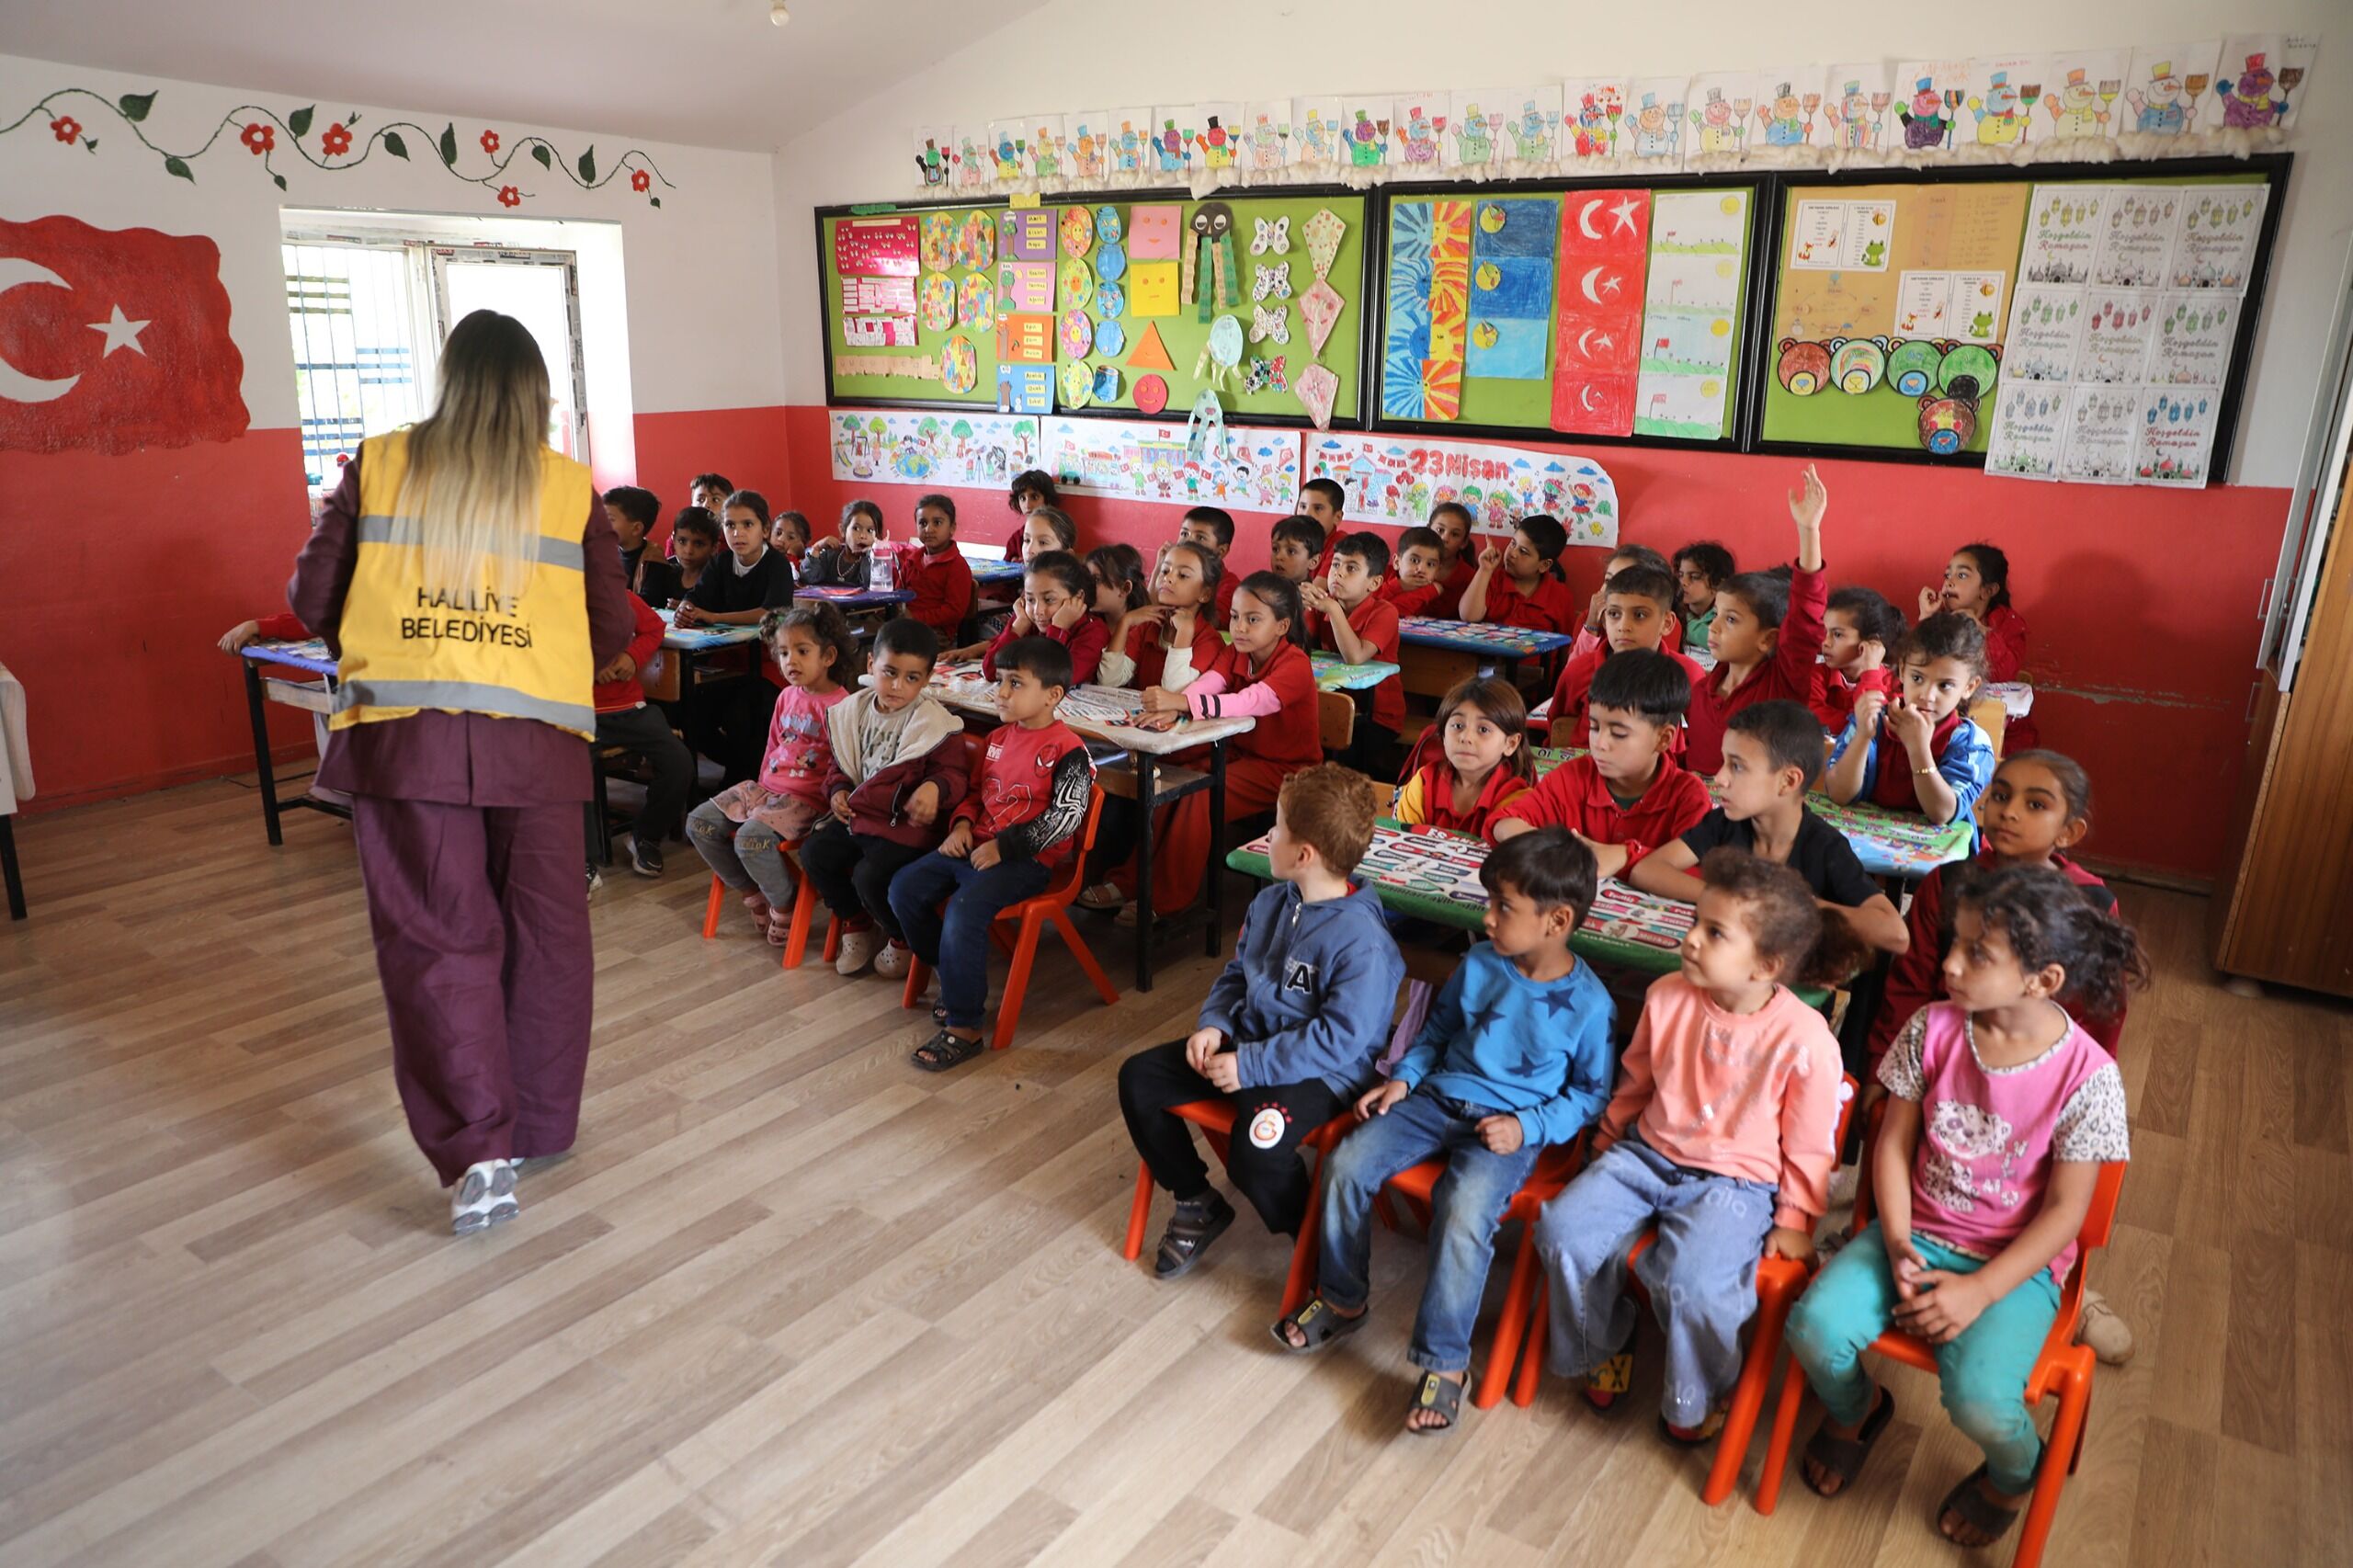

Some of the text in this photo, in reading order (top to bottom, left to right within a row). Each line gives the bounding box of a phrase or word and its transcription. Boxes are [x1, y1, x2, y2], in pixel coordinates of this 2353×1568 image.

[1407, 448, 1444, 476] 23
[417, 585, 519, 618] HALLİYE
[402, 616, 532, 648] BELEDİYESİ
